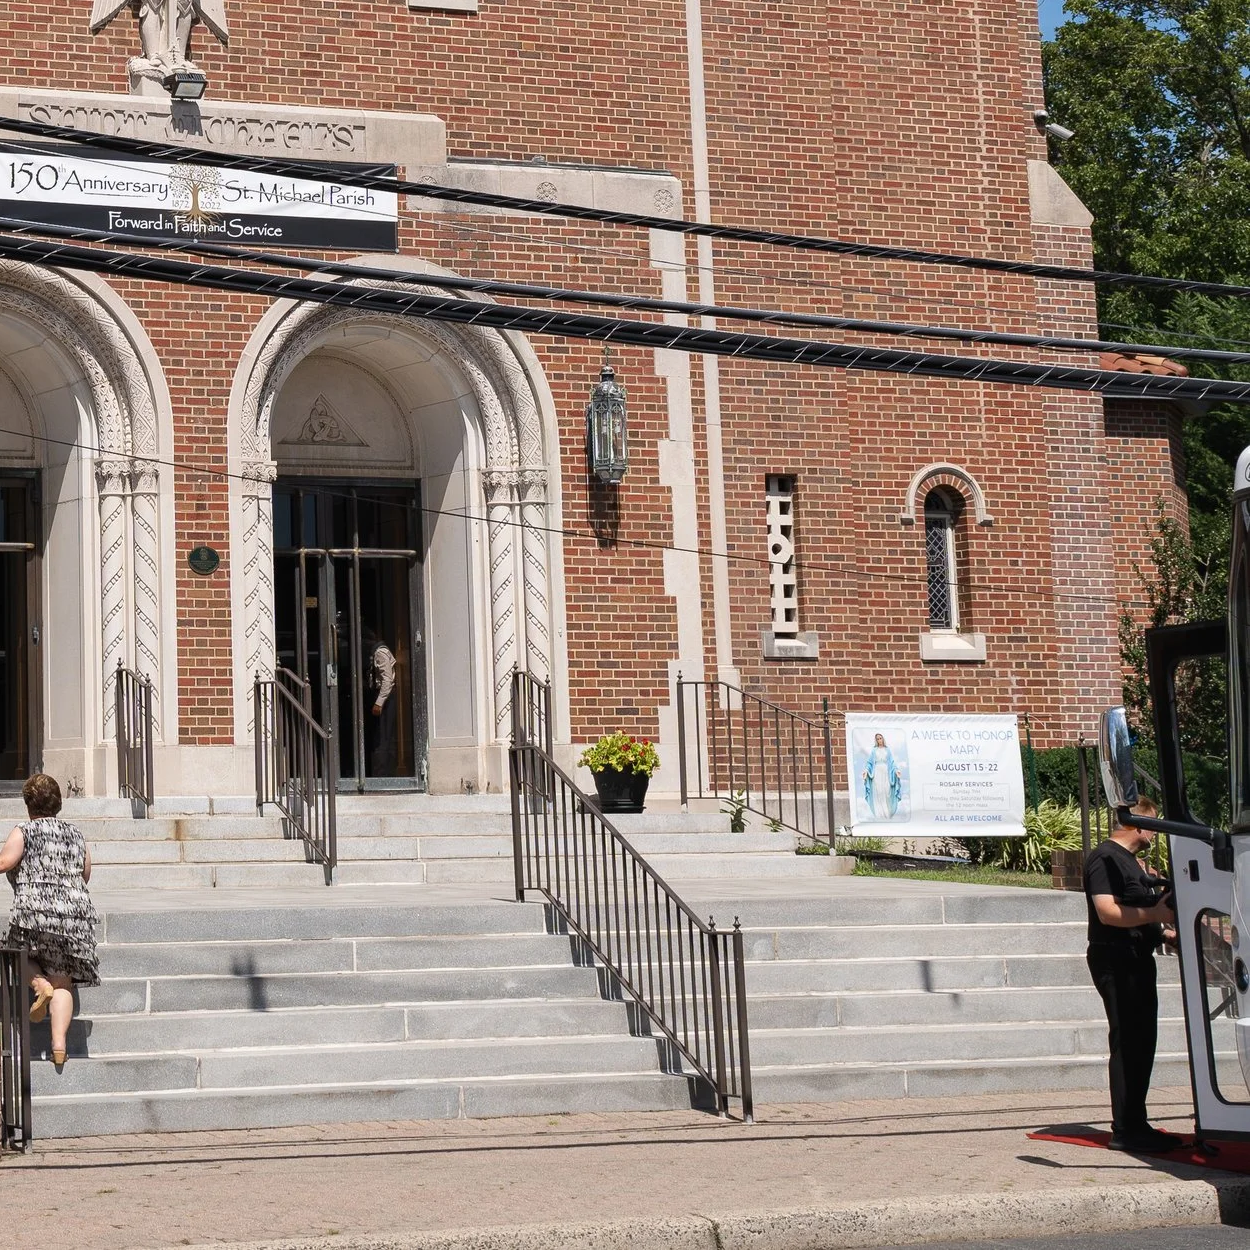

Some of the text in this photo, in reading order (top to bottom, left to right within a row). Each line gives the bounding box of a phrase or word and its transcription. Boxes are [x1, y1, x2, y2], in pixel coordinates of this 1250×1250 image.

[62, 170, 168, 201] Anniversary
[222, 180, 253, 202] St.
[259, 182, 325, 204] Michael
[330, 185, 375, 206] Parish
[171, 199, 221, 210] 1872 2022
[109, 211, 282, 237] Forward in Faith and Service
[911, 730, 1014, 740] A WEEK TO HONOR
[949, 744, 981, 755] MARY
[935, 763, 971, 772] AUGUST
